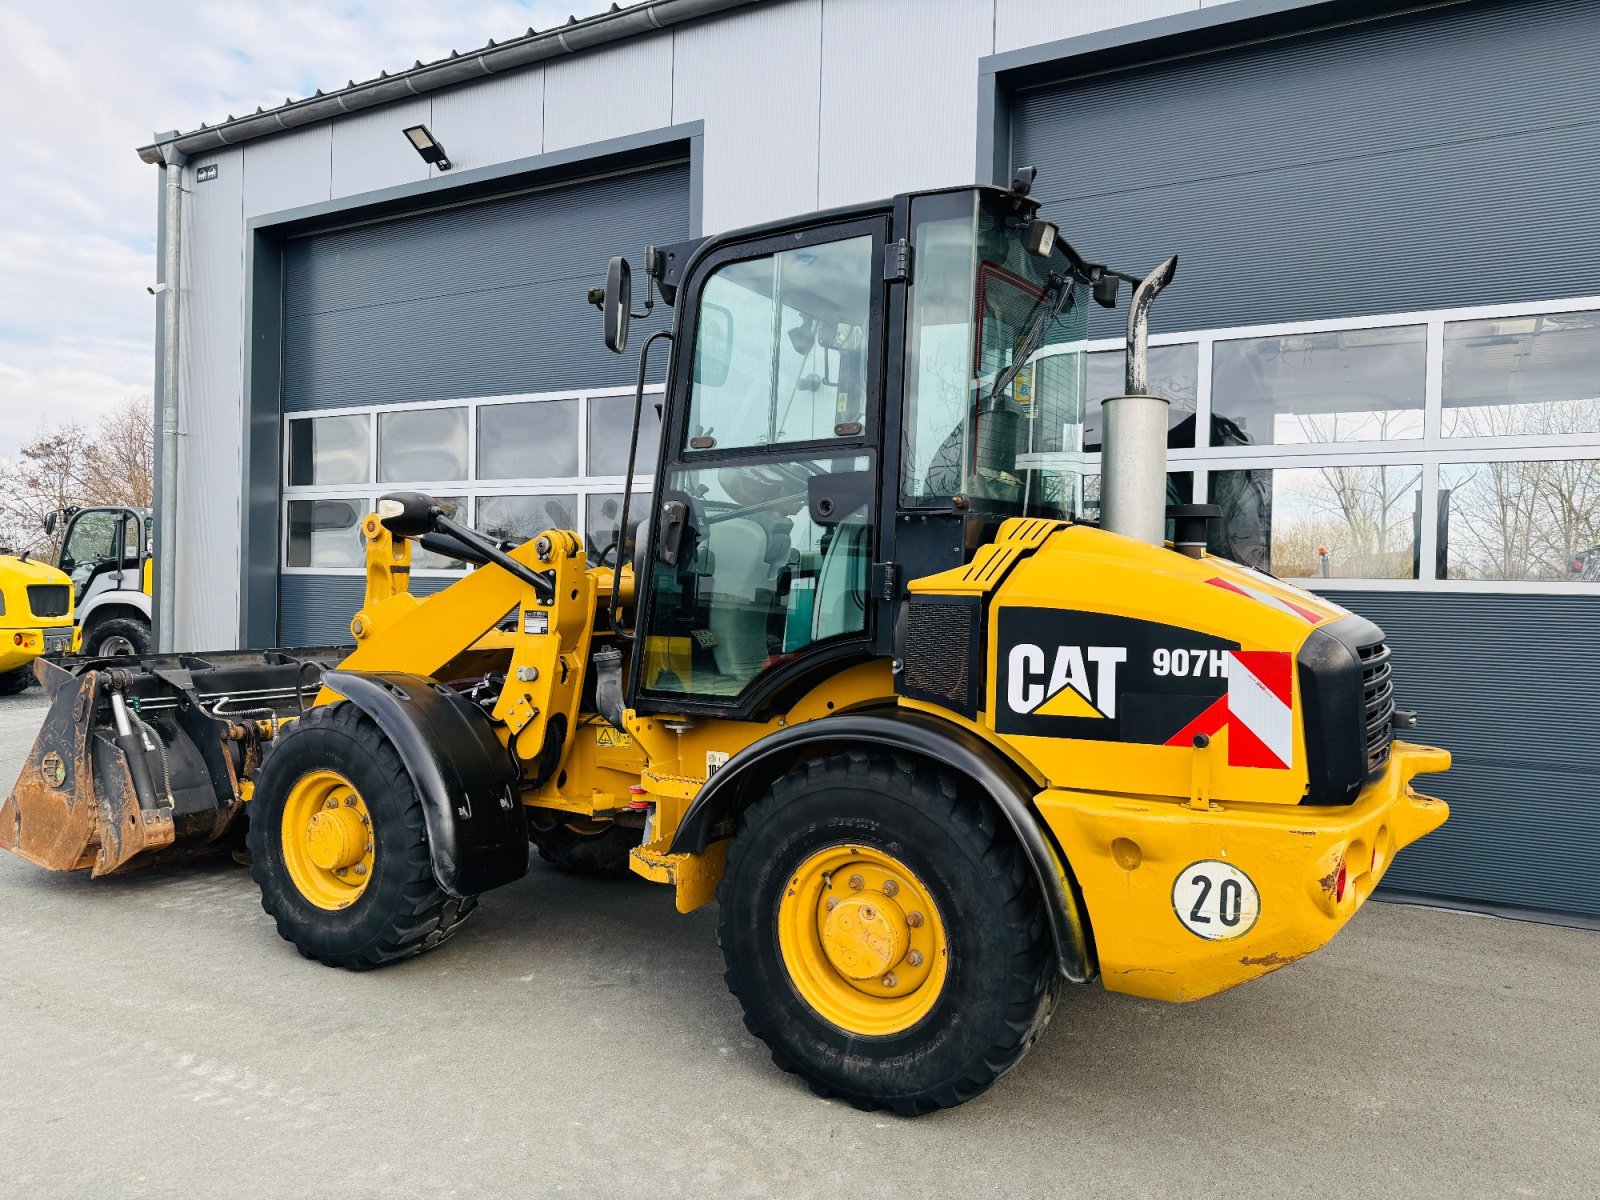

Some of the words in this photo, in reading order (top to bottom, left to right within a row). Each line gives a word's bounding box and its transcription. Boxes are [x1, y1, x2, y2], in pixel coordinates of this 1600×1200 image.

[1007, 643, 1127, 719] CAT
[1152, 648, 1229, 679] 907H
[1190, 874, 1242, 927] 20
